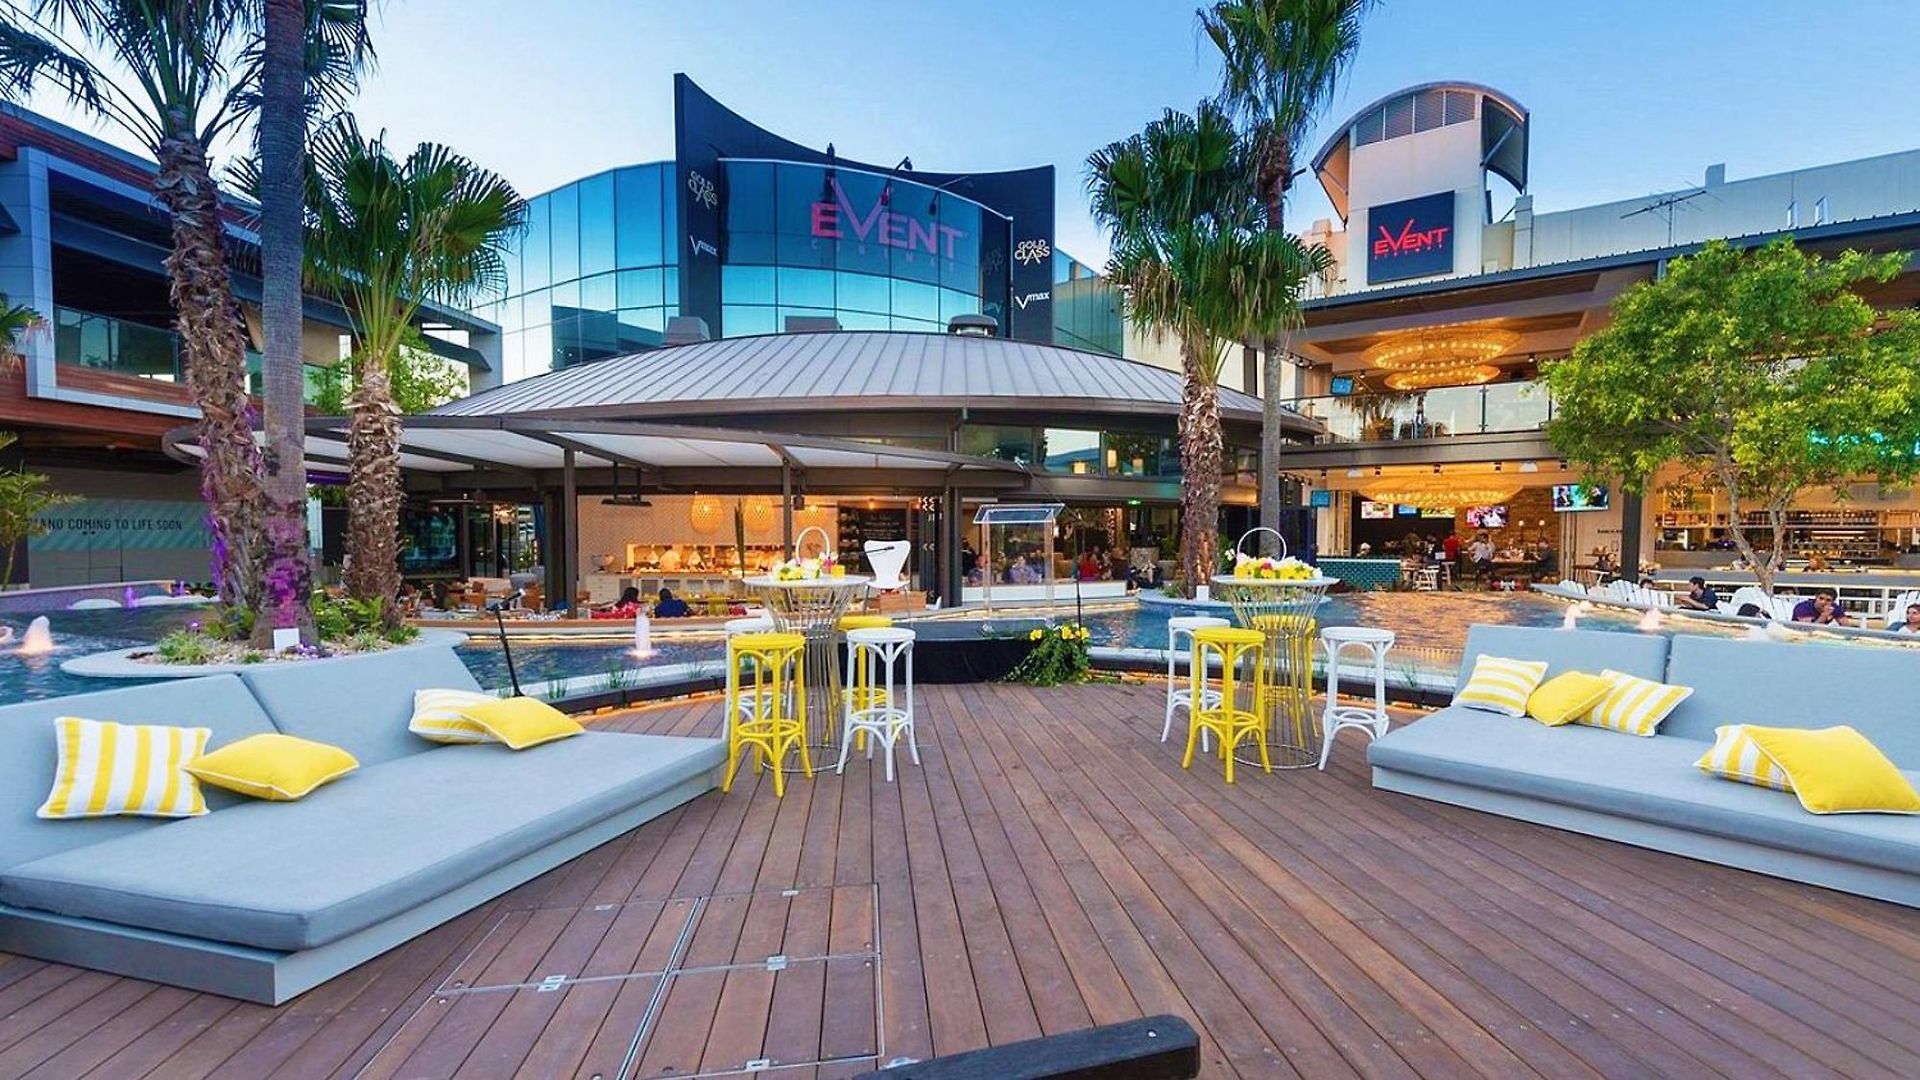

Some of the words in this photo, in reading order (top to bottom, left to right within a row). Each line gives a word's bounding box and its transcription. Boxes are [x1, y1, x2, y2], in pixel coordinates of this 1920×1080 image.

[690, 170, 714, 192] GOLD
[811, 176, 963, 259] EVENT
[1018, 239, 1046, 250] GOLD
[1374, 219, 1449, 255] EVENT
[1014, 246, 1051, 265] CLASS
[68, 518, 111, 530] COMING
[115, 519, 129, 530] TO
[132, 519, 152, 531] LIFE
[156, 519, 182, 531] SOON
